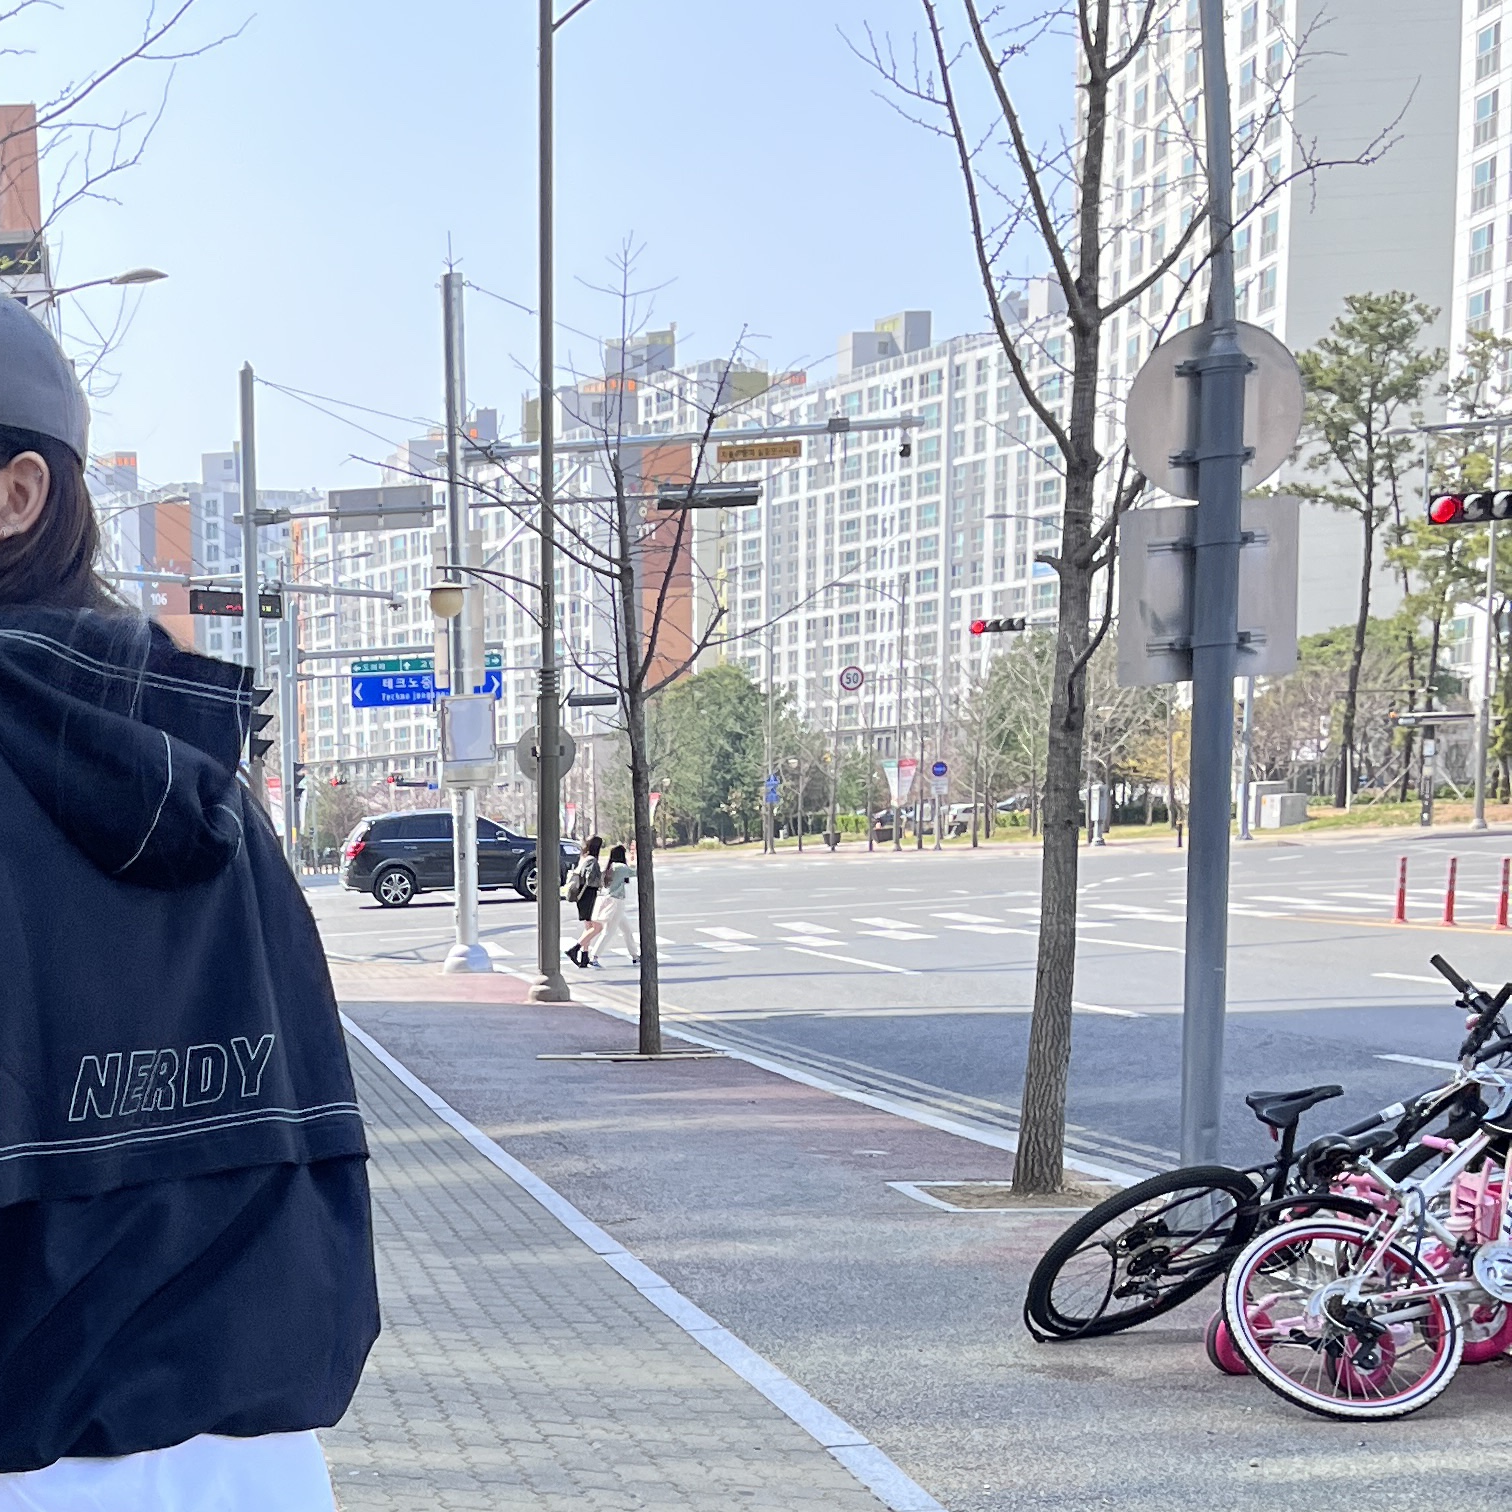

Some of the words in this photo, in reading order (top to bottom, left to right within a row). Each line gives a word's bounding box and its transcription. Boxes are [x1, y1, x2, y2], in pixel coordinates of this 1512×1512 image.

[150, 592, 168, 605] 106
[845, 672, 859, 684] 50
[68, 1034, 275, 1122] NERDY
